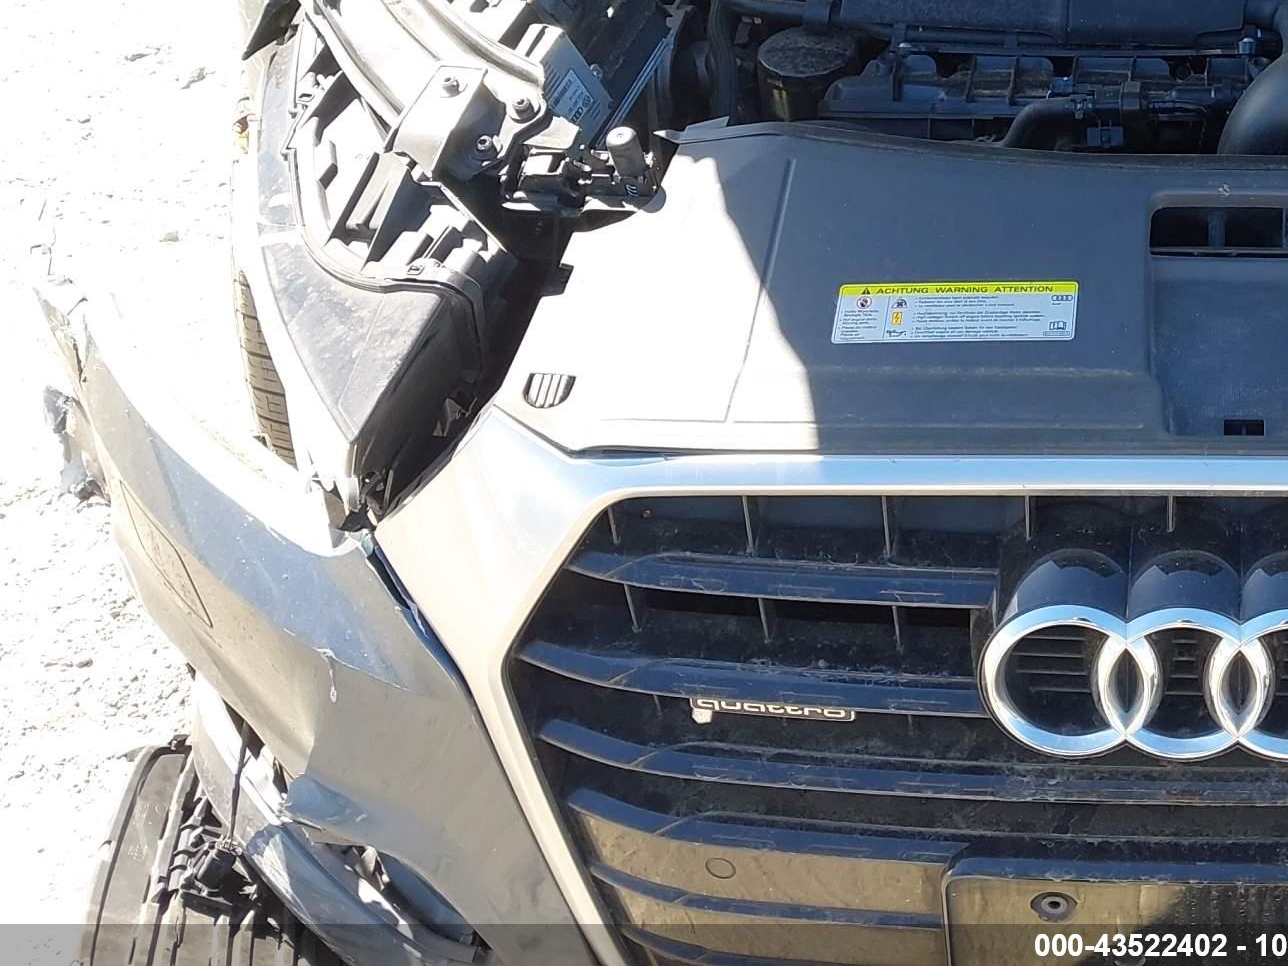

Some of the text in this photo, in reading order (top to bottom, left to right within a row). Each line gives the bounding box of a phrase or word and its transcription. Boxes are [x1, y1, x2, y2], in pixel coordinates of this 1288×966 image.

[876, 285, 1053, 295] ACHTUNG WARNING ATTENTION
[697, 698, 846, 719] quattro
